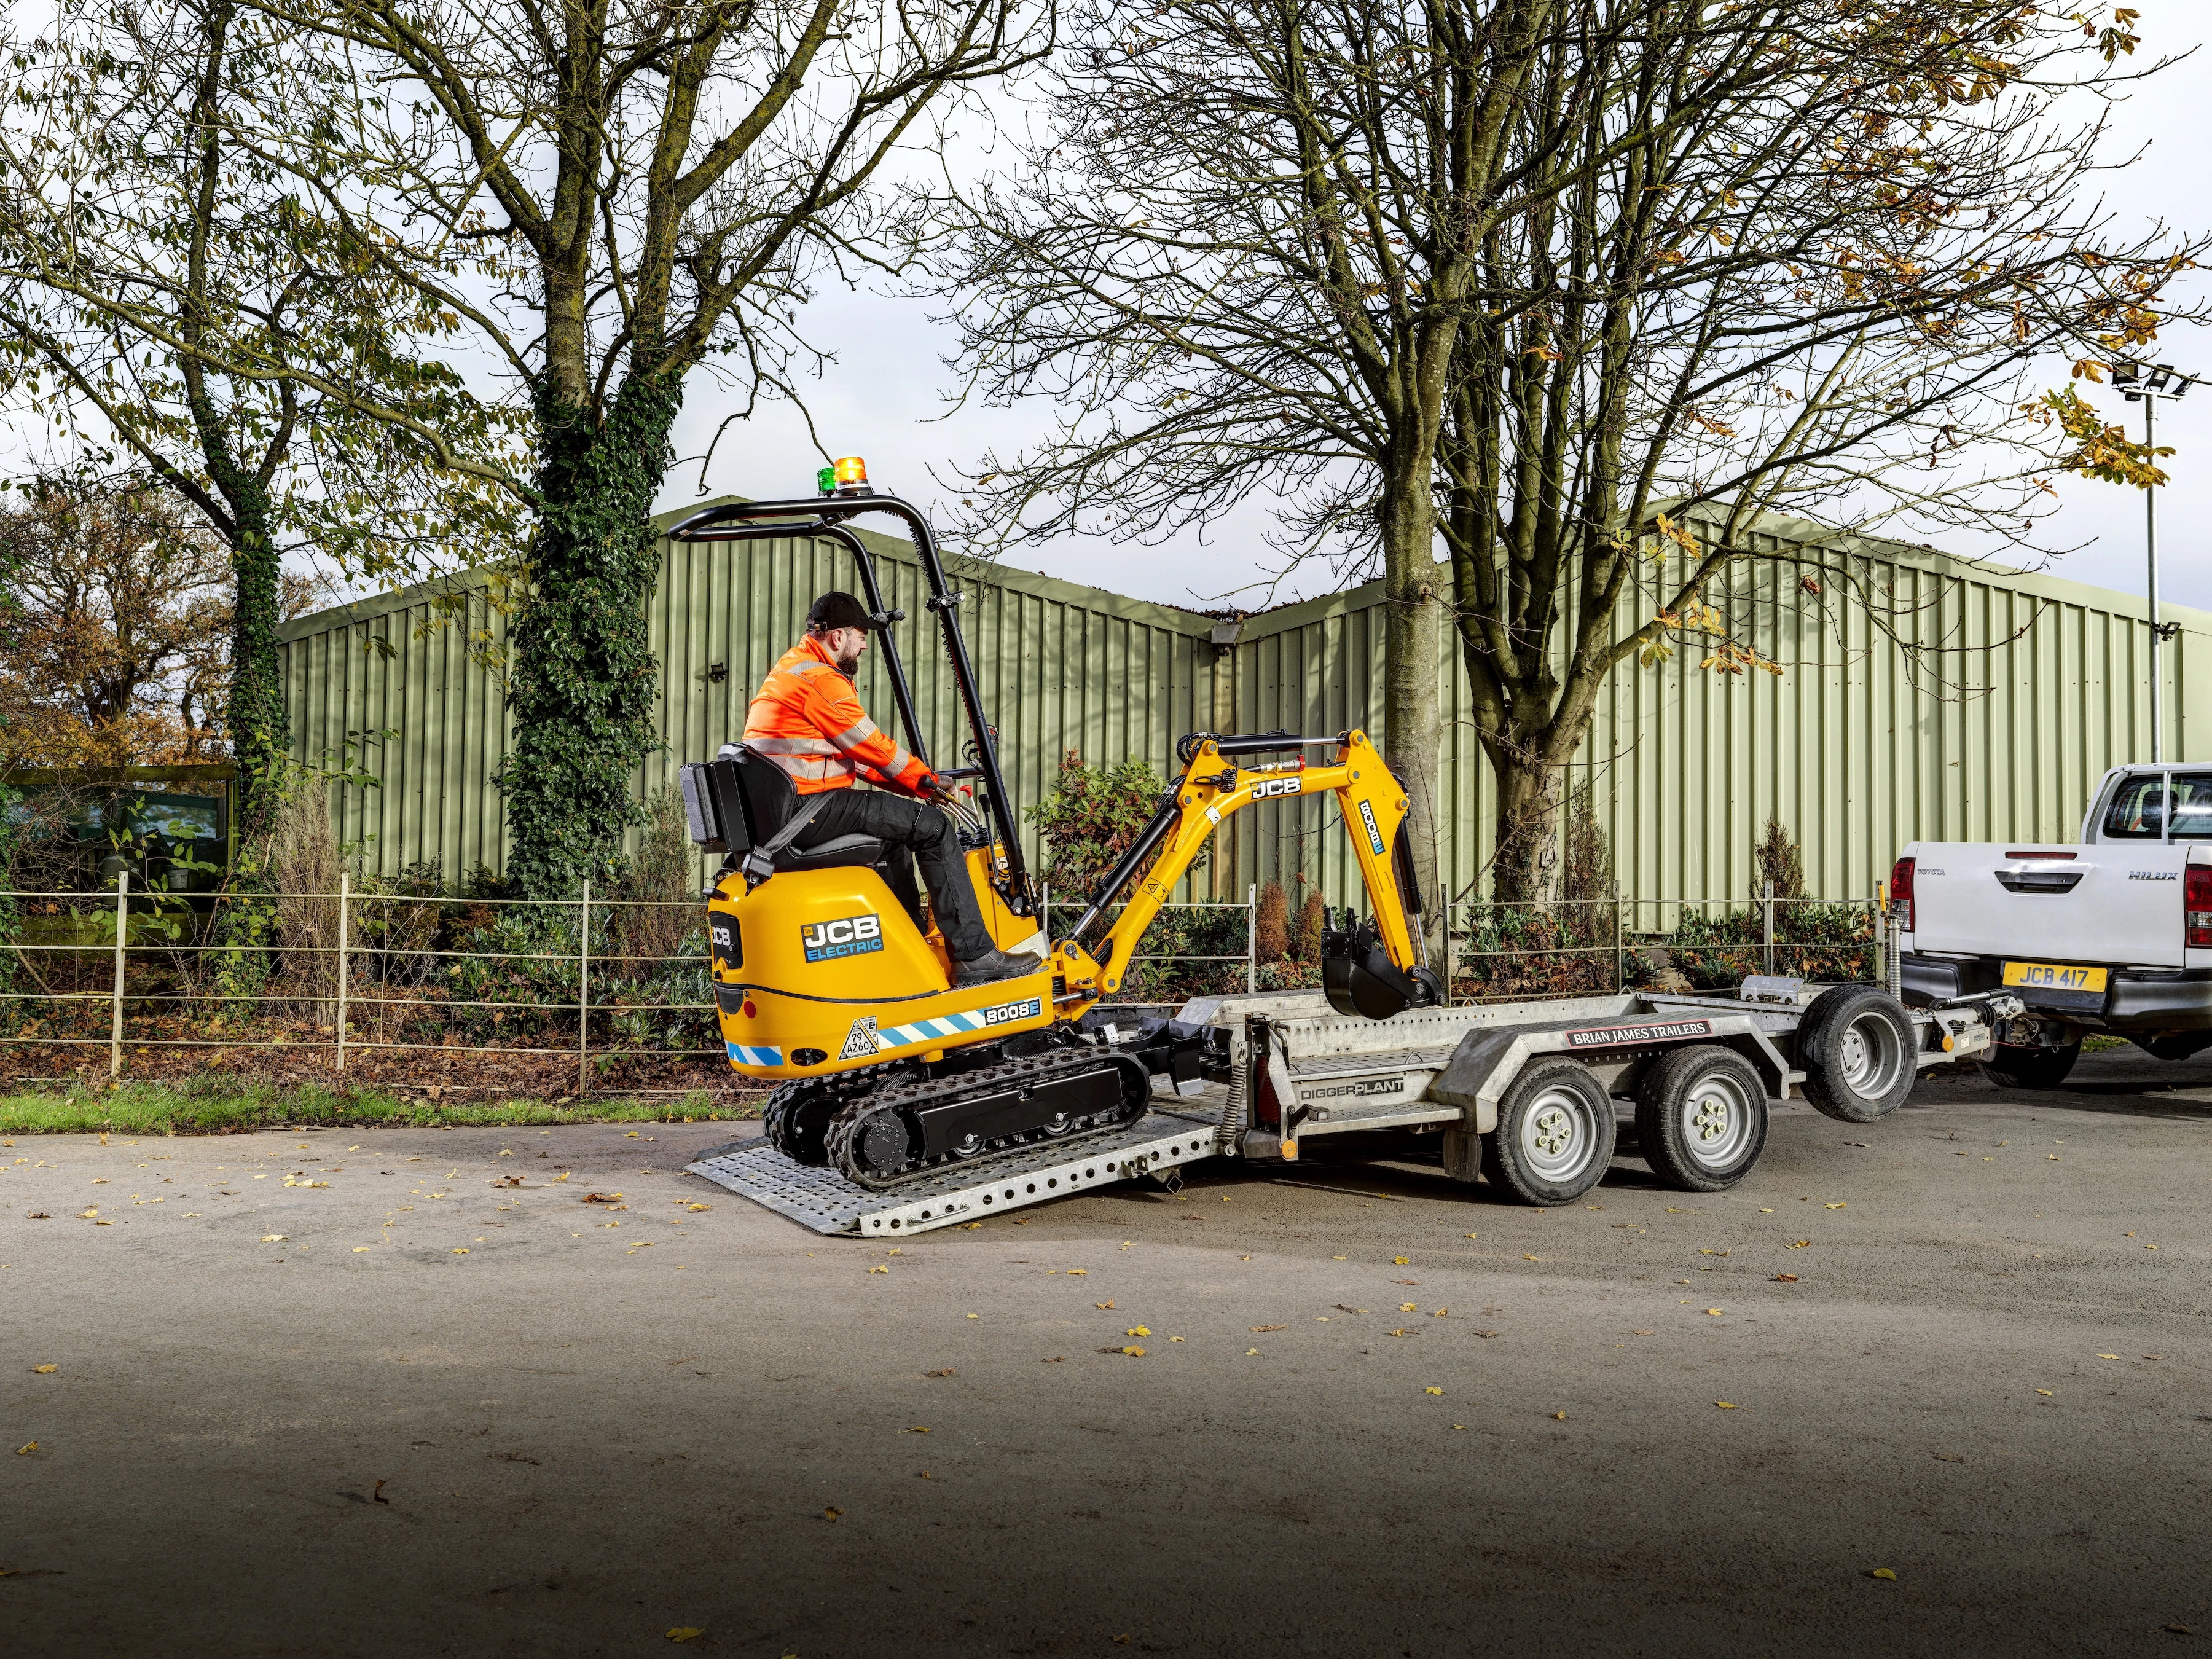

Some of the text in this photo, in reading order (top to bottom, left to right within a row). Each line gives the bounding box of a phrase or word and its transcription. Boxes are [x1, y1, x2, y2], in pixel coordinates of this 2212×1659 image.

[1253, 777, 1301, 799] JCB
[1360, 802, 1384, 855] 8008E
[2128, 871, 2179, 881] HILUX
[712, 927, 731, 946] JCB
[805, 916, 880, 947] JCB
[807, 938, 882, 961] ELECTRIC
[2020, 967, 2088, 987] JCB 417
[986, 1001, 1040, 1023] 8008E
[851, 1033, 862, 1043] 79
[1573, 1022, 1706, 1045] BRIAN JAMES TRAILERS
[847, 1041, 869, 1054] AZ60
